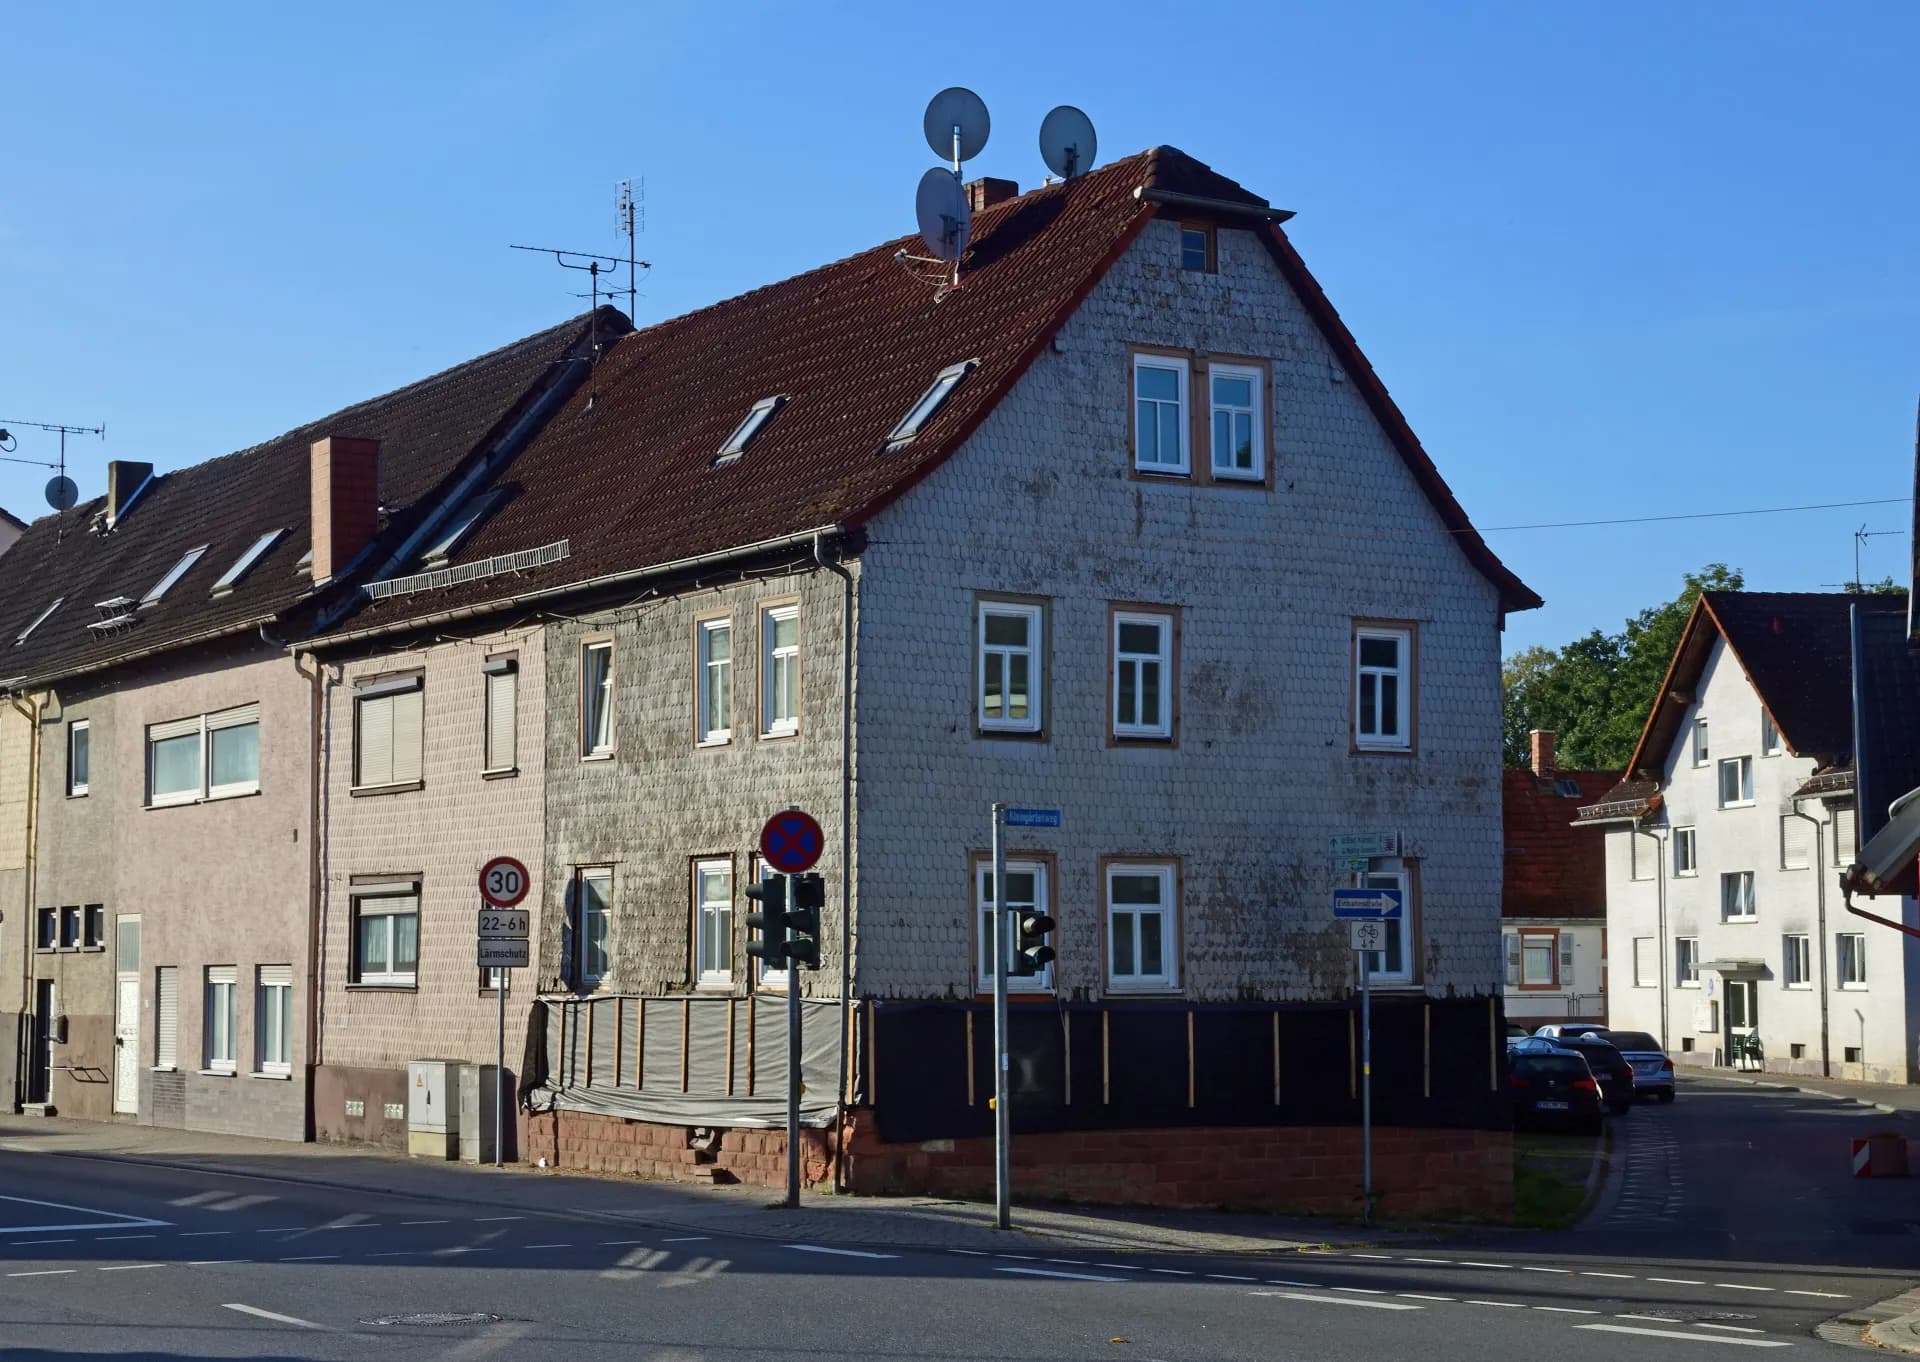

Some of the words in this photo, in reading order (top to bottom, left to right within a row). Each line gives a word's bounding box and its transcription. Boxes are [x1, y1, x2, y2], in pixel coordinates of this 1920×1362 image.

[490, 871, 519, 893] 30
[482, 916, 516, 931] 22-6
[519, 917, 526, 931] h
[480, 947, 527, 959] Lärmschutz
